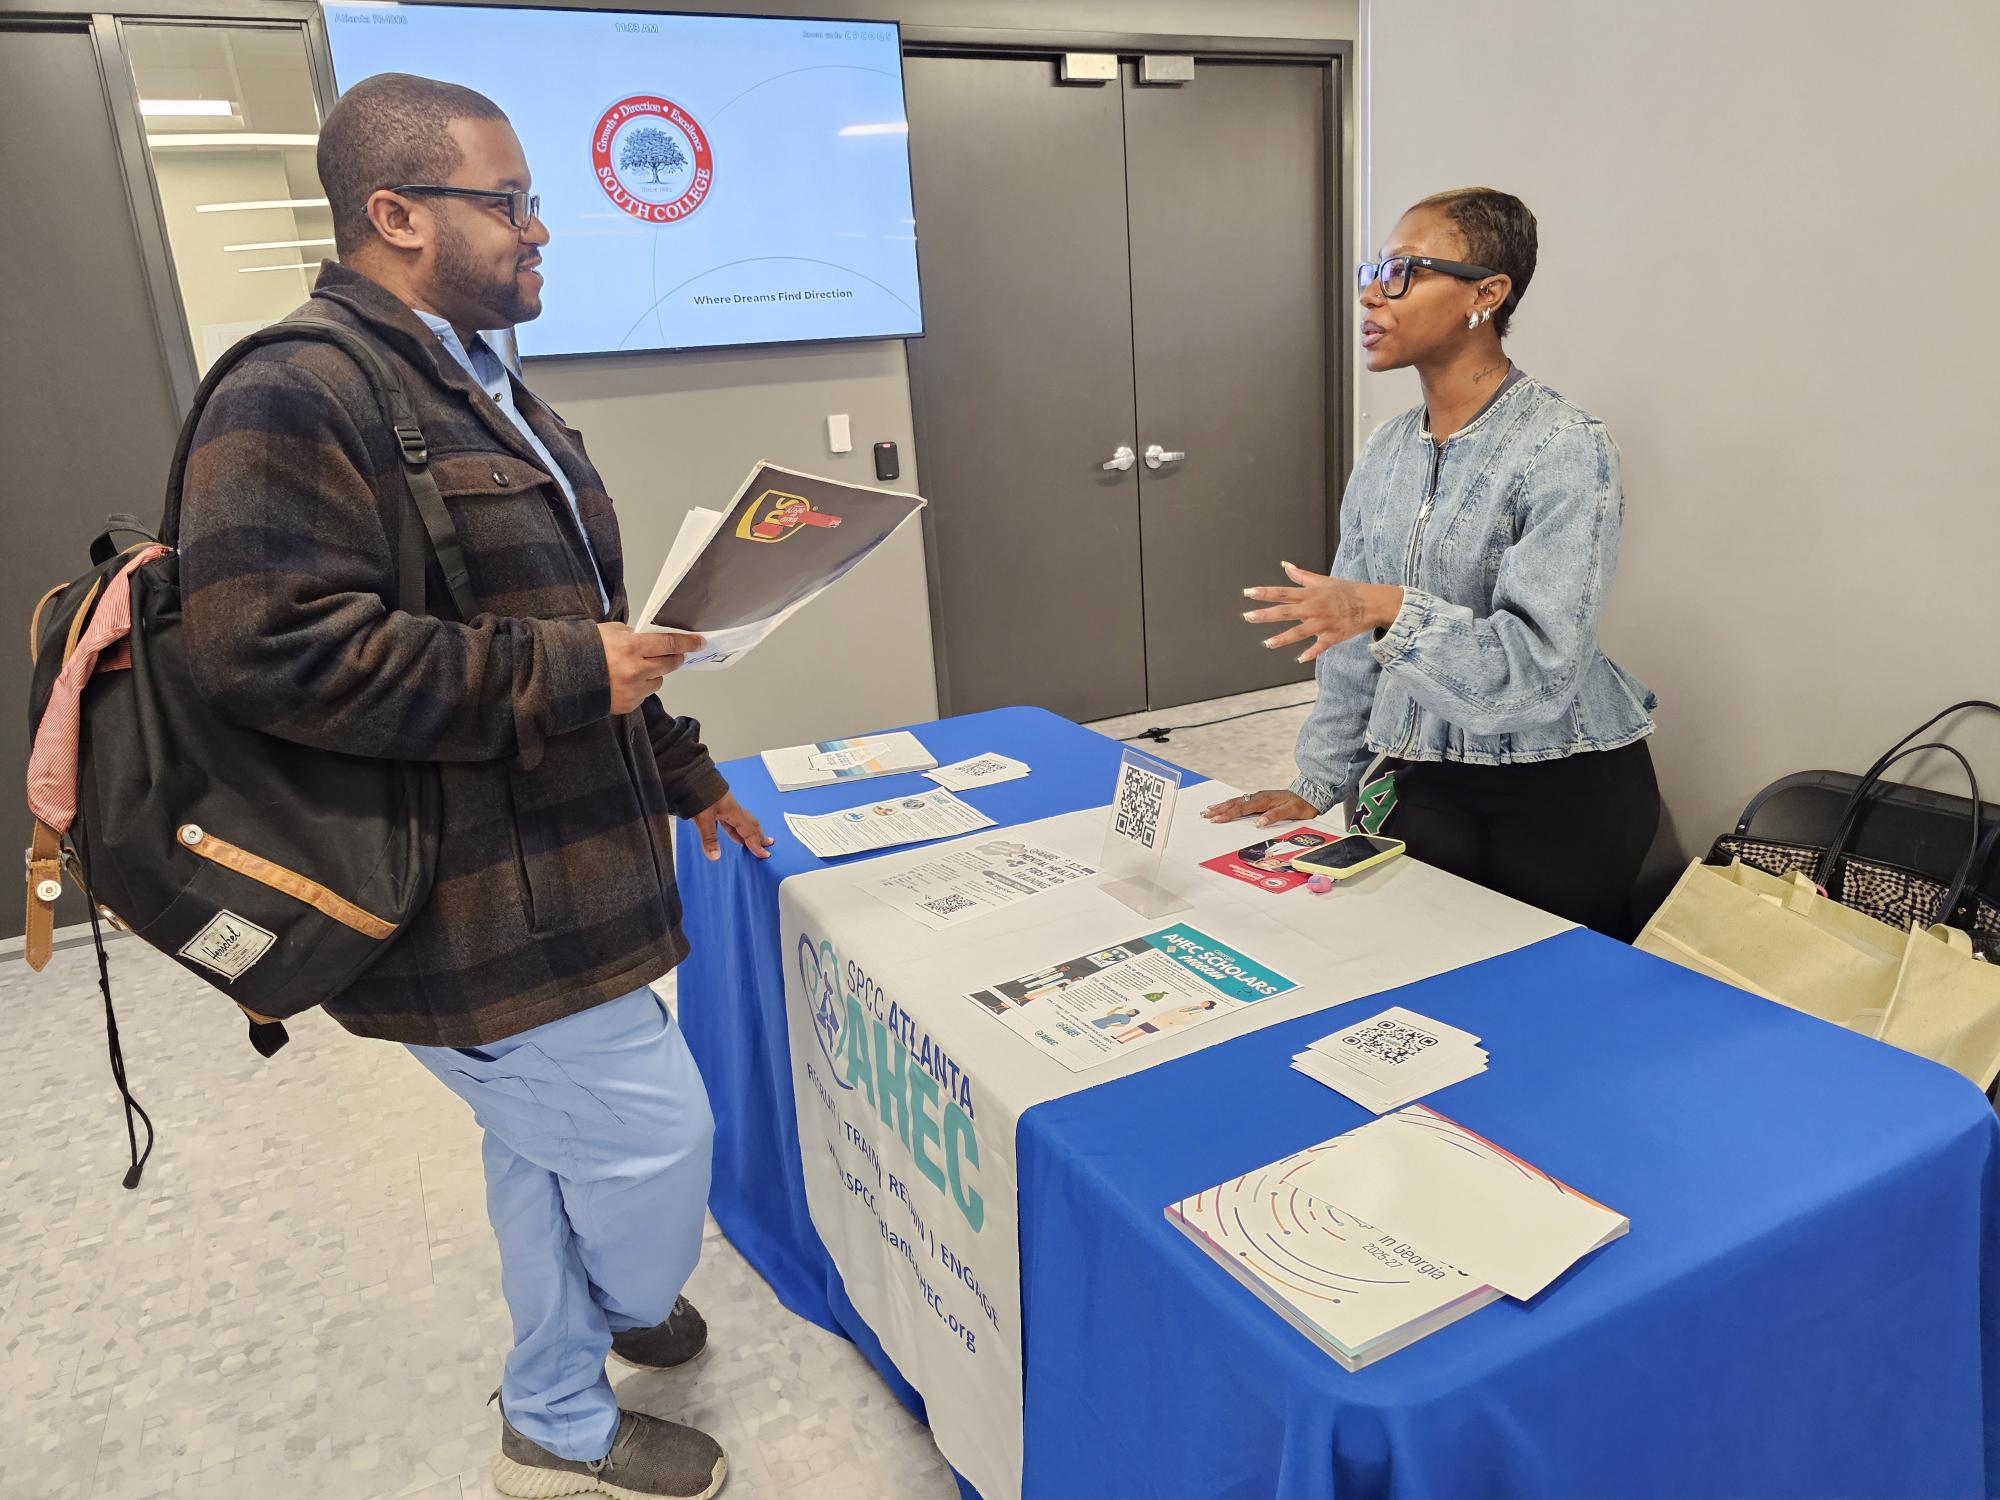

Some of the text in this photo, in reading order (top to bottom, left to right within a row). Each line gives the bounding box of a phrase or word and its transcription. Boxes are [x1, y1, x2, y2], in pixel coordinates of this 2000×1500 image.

[641, 23, 659, 33] AM
[596, 101, 703, 153] Growth Direction Excellence
[598, 167, 710, 221] SOUTH COLLEGE
[693, 289, 853, 305] Where Dreams Find Direction
[1012, 871, 1052, 889] TRAINING
[1018, 853, 1047, 867] MENTAL
[1046, 865, 1080, 880] HEALTH
[1025, 866, 1065, 884] FIRST AID
[201, 924, 241, 963] Herschel
[1162, 933, 1204, 955] AHEC
[1200, 951, 1278, 995] SCHOLARS
[1177, 954, 1227, 980] PROGRAM
[847, 959, 975, 1121] SPCC ATLANTA
[846, 992, 985, 1234] AHEC
[1362, 1242, 1403, 1268] 2025-27
[1392, 1243, 1446, 1280] Georgia
